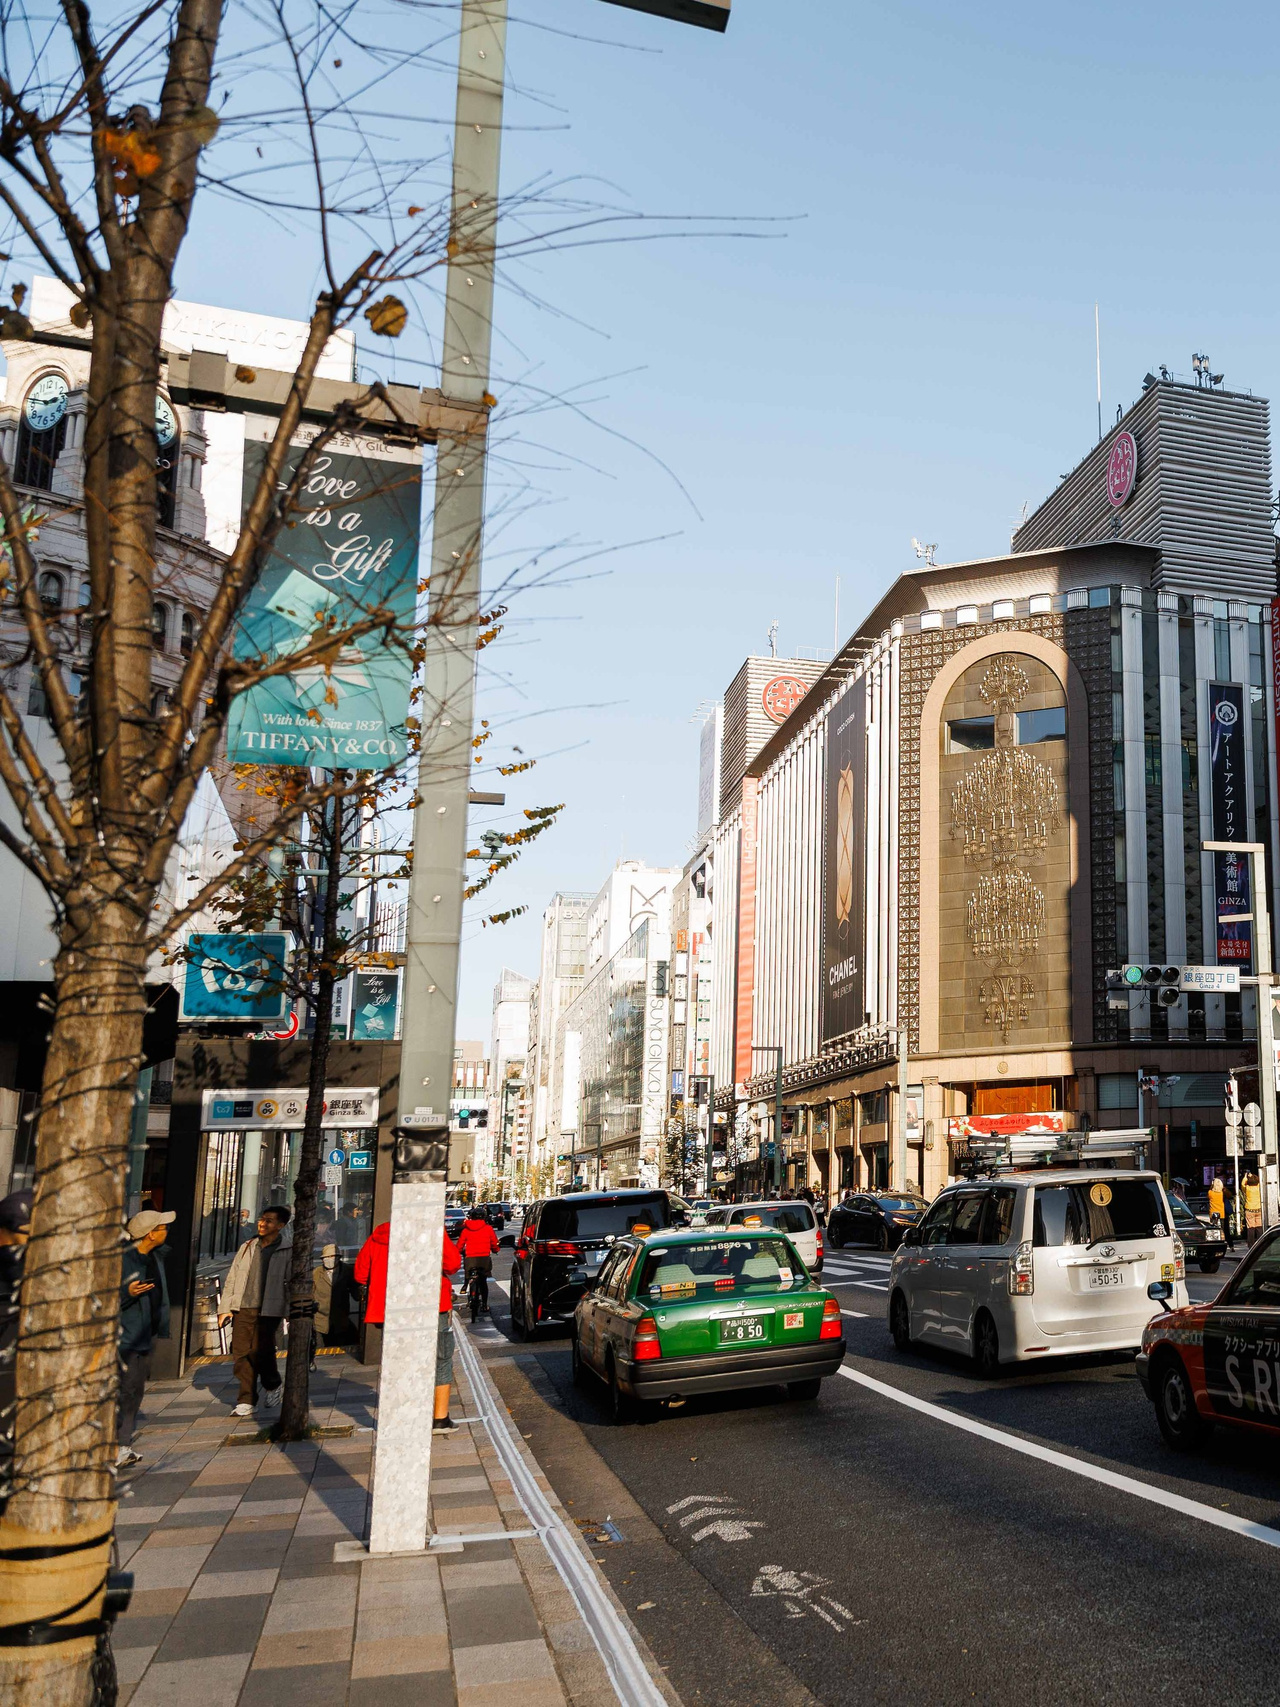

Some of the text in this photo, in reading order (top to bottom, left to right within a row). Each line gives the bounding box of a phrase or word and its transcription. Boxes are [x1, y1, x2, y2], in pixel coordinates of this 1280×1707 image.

[366, 441, 393, 454] GILC
[301, 500, 363, 532] is a
[312, 534, 394, 587] Gift
[263, 713, 383, 732] With love, Since 1837
[243, 731, 398, 756] TIFFANY&CO.
[744, 783, 755, 864] MITSUKOSHI
[1222, 732, 1239, 892] アートアクアリウ美術館
[1217, 897, 1247, 906] GINZA
[829, 955, 858, 986] CHANEL
[1184, 972, 1235, 983] 銀座四丁目
[329, 1100, 363, 1110] 銀座駅
[1097, 1272, 1124, 1286] 50-51
[1224, 1334, 1280, 1358] タクシーアプリ
